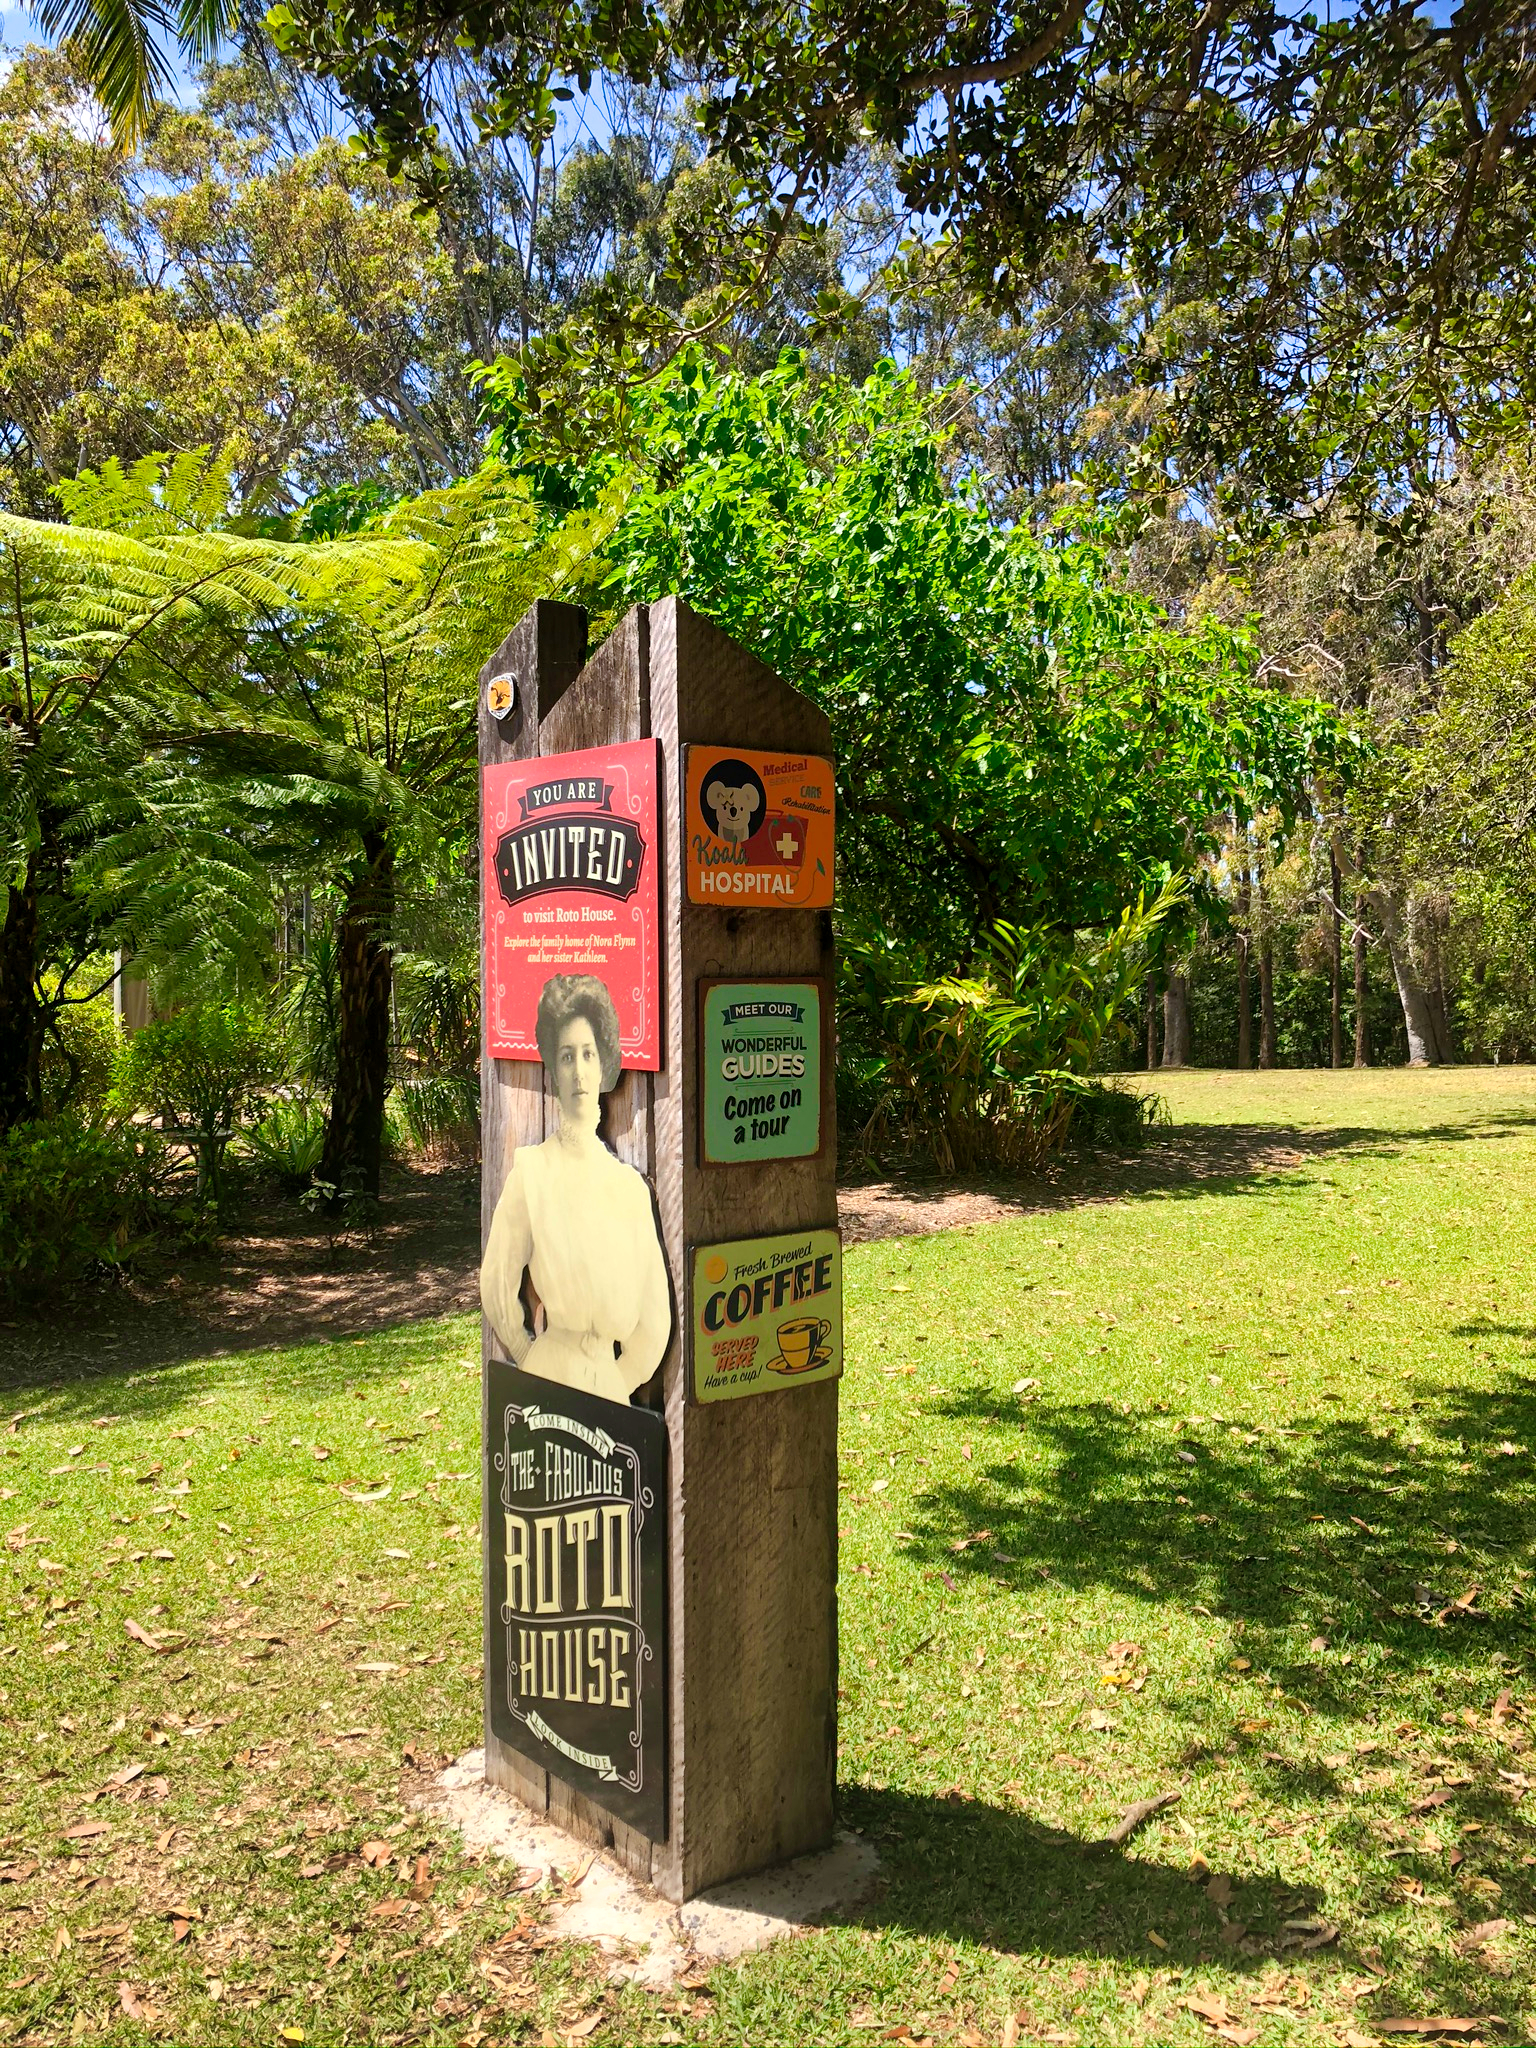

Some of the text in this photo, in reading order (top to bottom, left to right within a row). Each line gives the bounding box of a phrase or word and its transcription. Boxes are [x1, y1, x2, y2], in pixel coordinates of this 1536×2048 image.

[763, 759, 807, 776] Medical
[533, 782, 596, 806] YOU ARE
[801, 786, 821, 798] CARE
[782, 797, 831, 814] Rehabilitation
[510, 826, 626, 891] INVITED
[692, 834, 749, 866] Koala
[701, 871, 794, 894] HOSPITAL
[523, 907, 616, 923] to visit Roto House.
[504, 934, 635, 950] Explore the family home of Nora Flynn
[528, 950, 608, 963] and her sister Kathleen.
[735, 1004, 792, 1016] MEET OUR
[721, 1036, 807, 1053] WONDERFUL
[721, 1054, 805, 1081] GUIDES
[725, 1088, 801, 1120] Come on
[734, 1115, 790, 1144] a tour
[734, 1242, 813, 1281] Fresh Brewed
[701, 1253, 833, 1336] COFFEE
[711, 1335, 759, 1356] SERVED
[716, 1350, 756, 1373] HERE
[704, 1365, 762, 1389] Have a cup!
[533, 1416, 604, 1455] COME INSIDE
[511, 1441, 622, 1501] THE FABULOUS
[504, 1505, 634, 1614] ROTO
[519, 1628, 632, 1708] HOUSE
[535, 1716, 608, 1768] LOOK INSIDE
